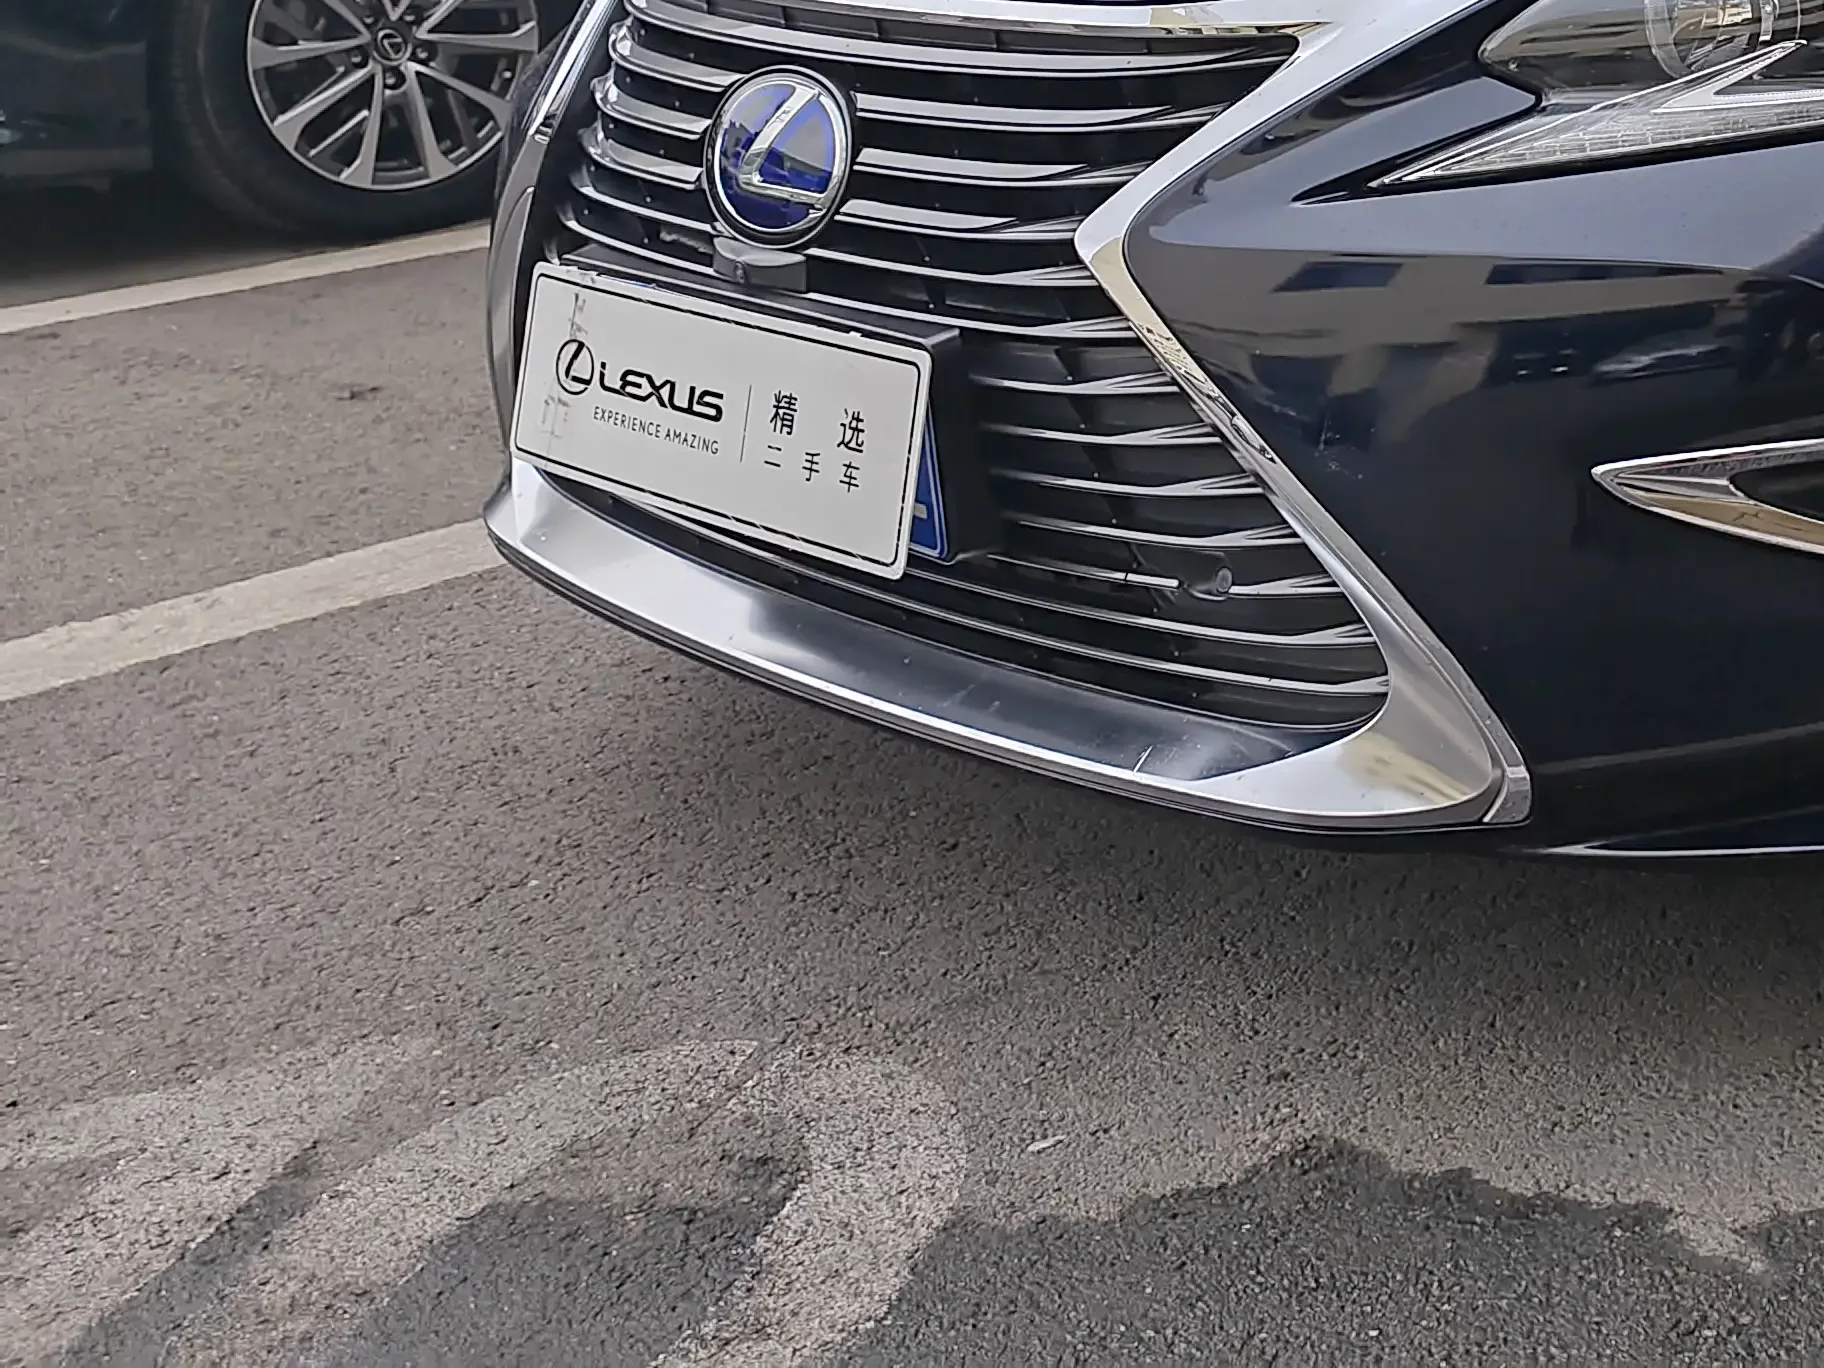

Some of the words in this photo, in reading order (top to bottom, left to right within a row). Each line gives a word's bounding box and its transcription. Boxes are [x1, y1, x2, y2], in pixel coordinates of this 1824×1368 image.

[599, 362, 724, 422] LEXUS
[593, 406, 661, 439] EXPERIENCE
[664, 428, 719, 455] AMAZING
[769, 390, 866, 454] 精选
[764, 444, 860, 493] 二手车
